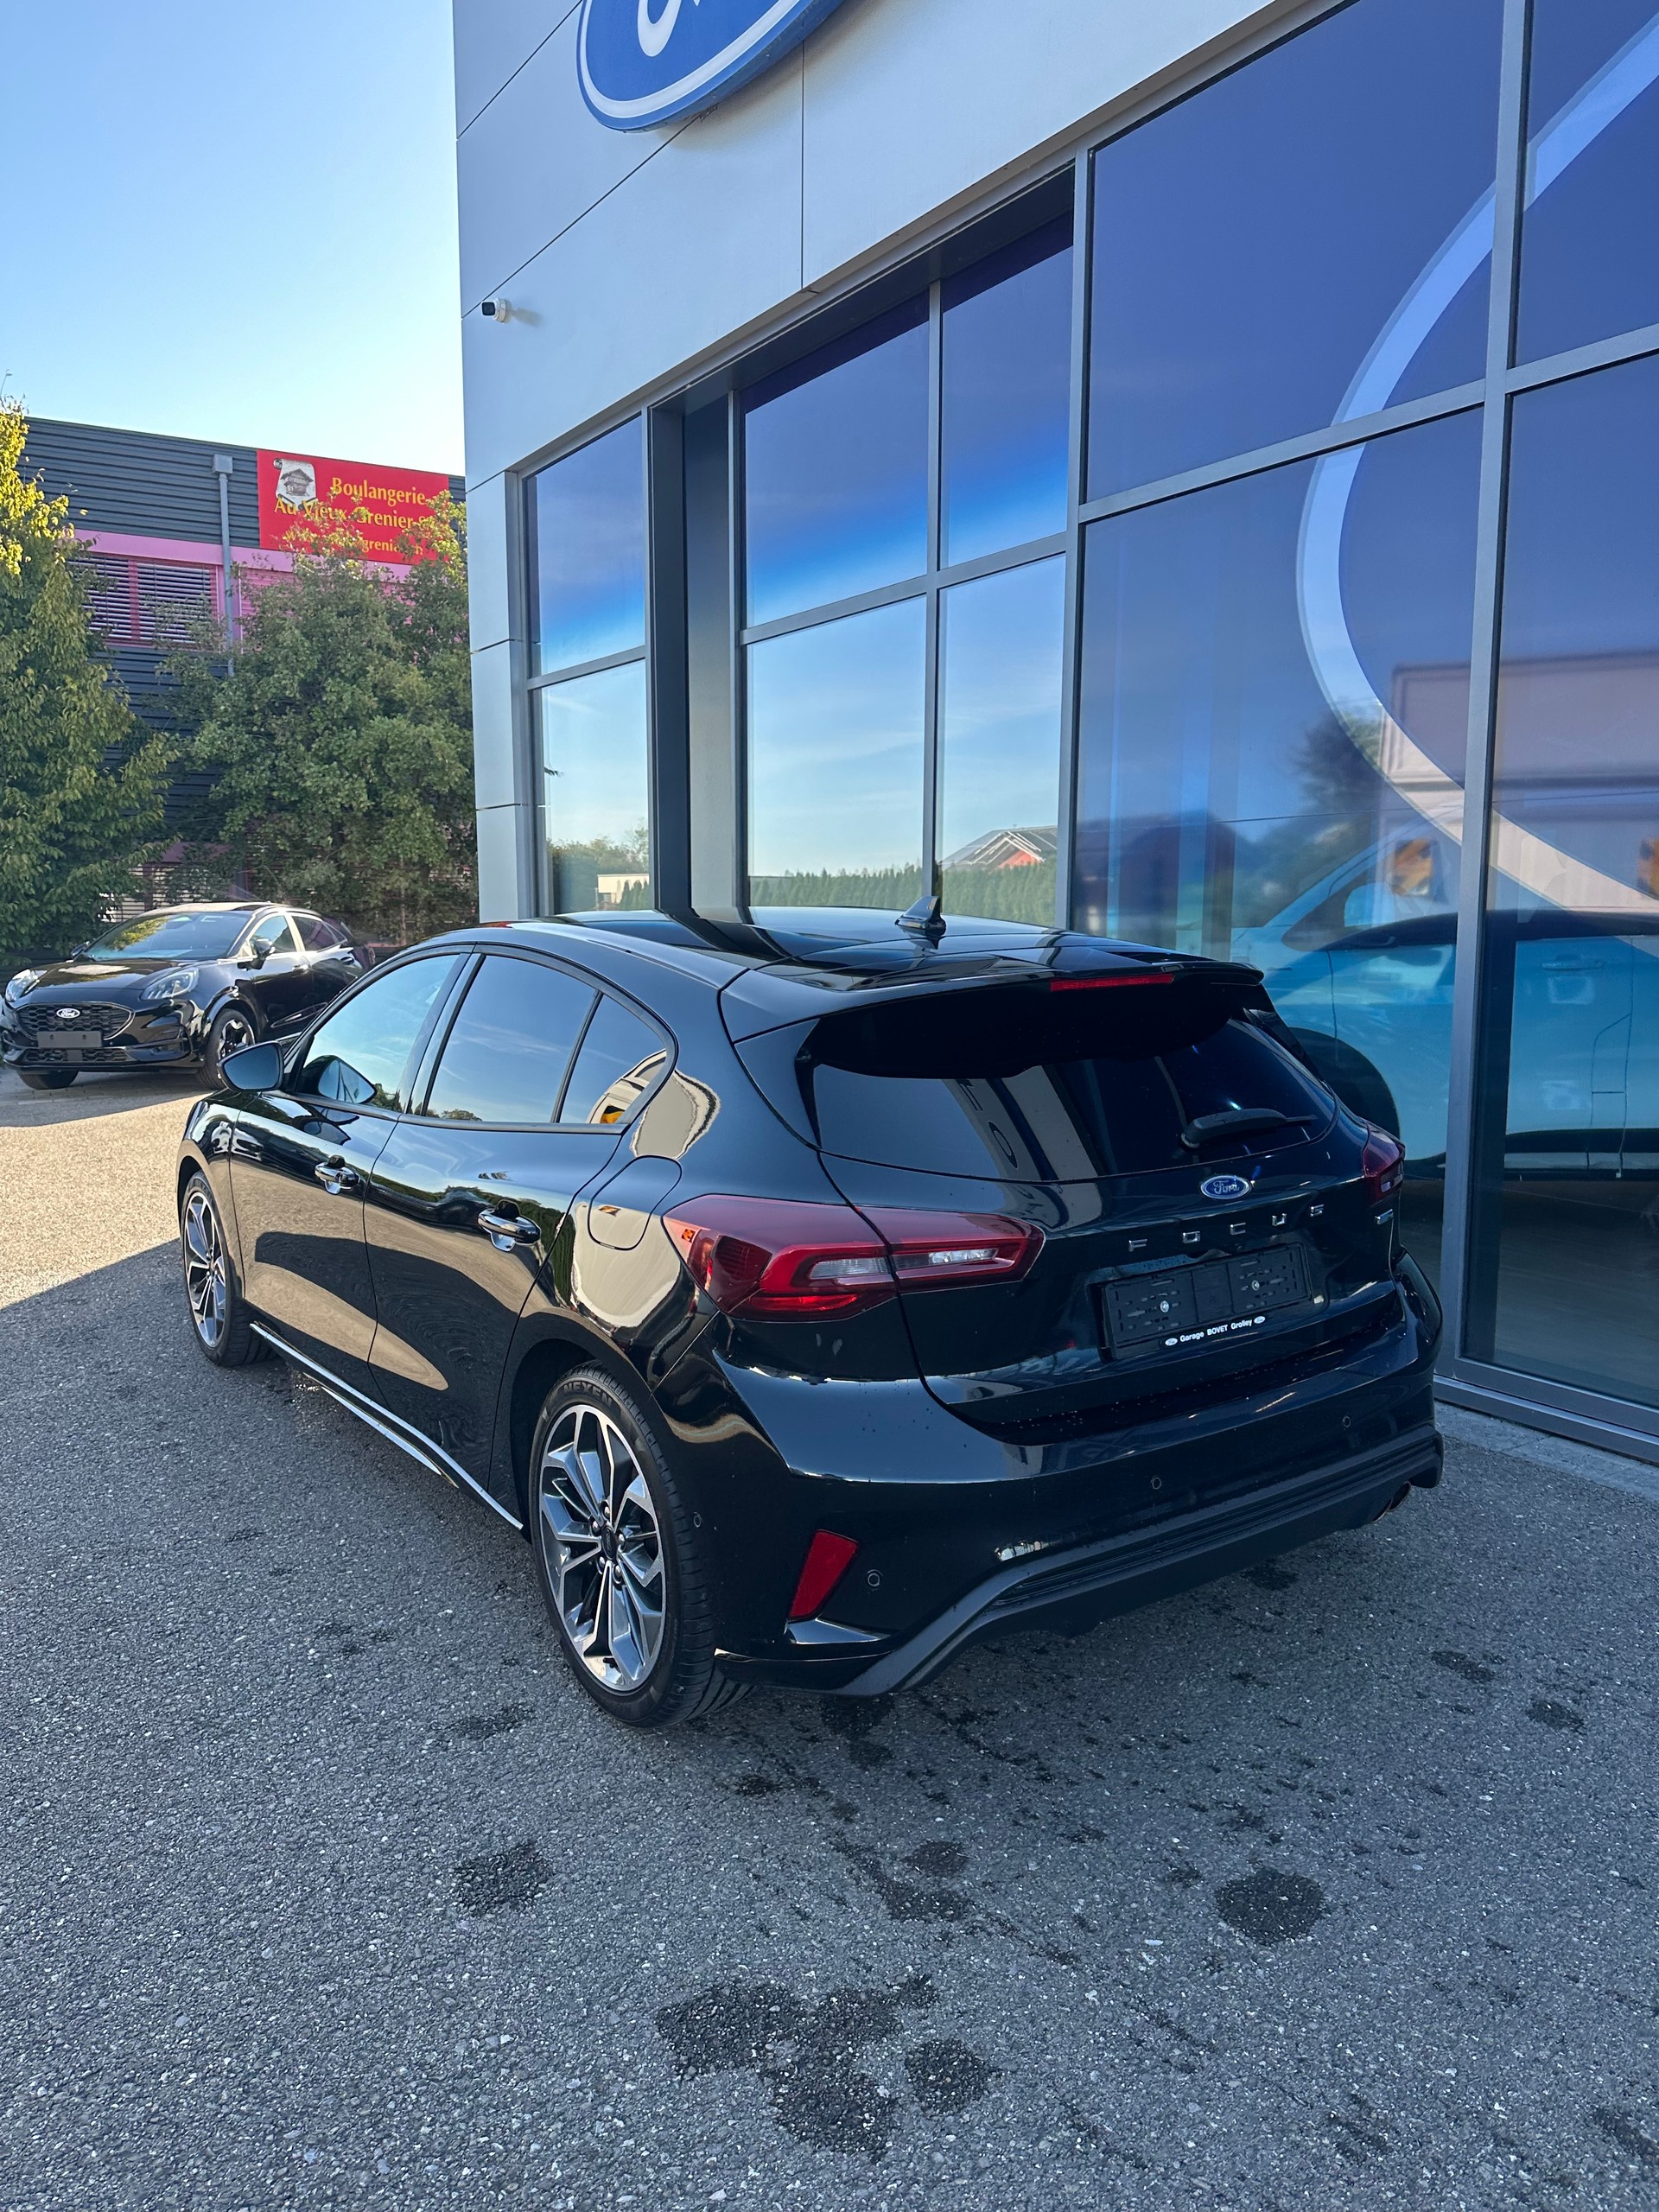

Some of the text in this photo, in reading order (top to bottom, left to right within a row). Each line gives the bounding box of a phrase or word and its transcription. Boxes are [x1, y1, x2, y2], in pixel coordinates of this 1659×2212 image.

[332, 477, 425, 506] Boulangerie
[274, 497, 297, 516] Au
[1213, 1179, 1240, 1194] Ford
[1128, 1205, 1325, 1252] FOCUS
[1179, 1332, 1205, 1343] Garage
[1207, 1325, 1229, 1336] BOVET
